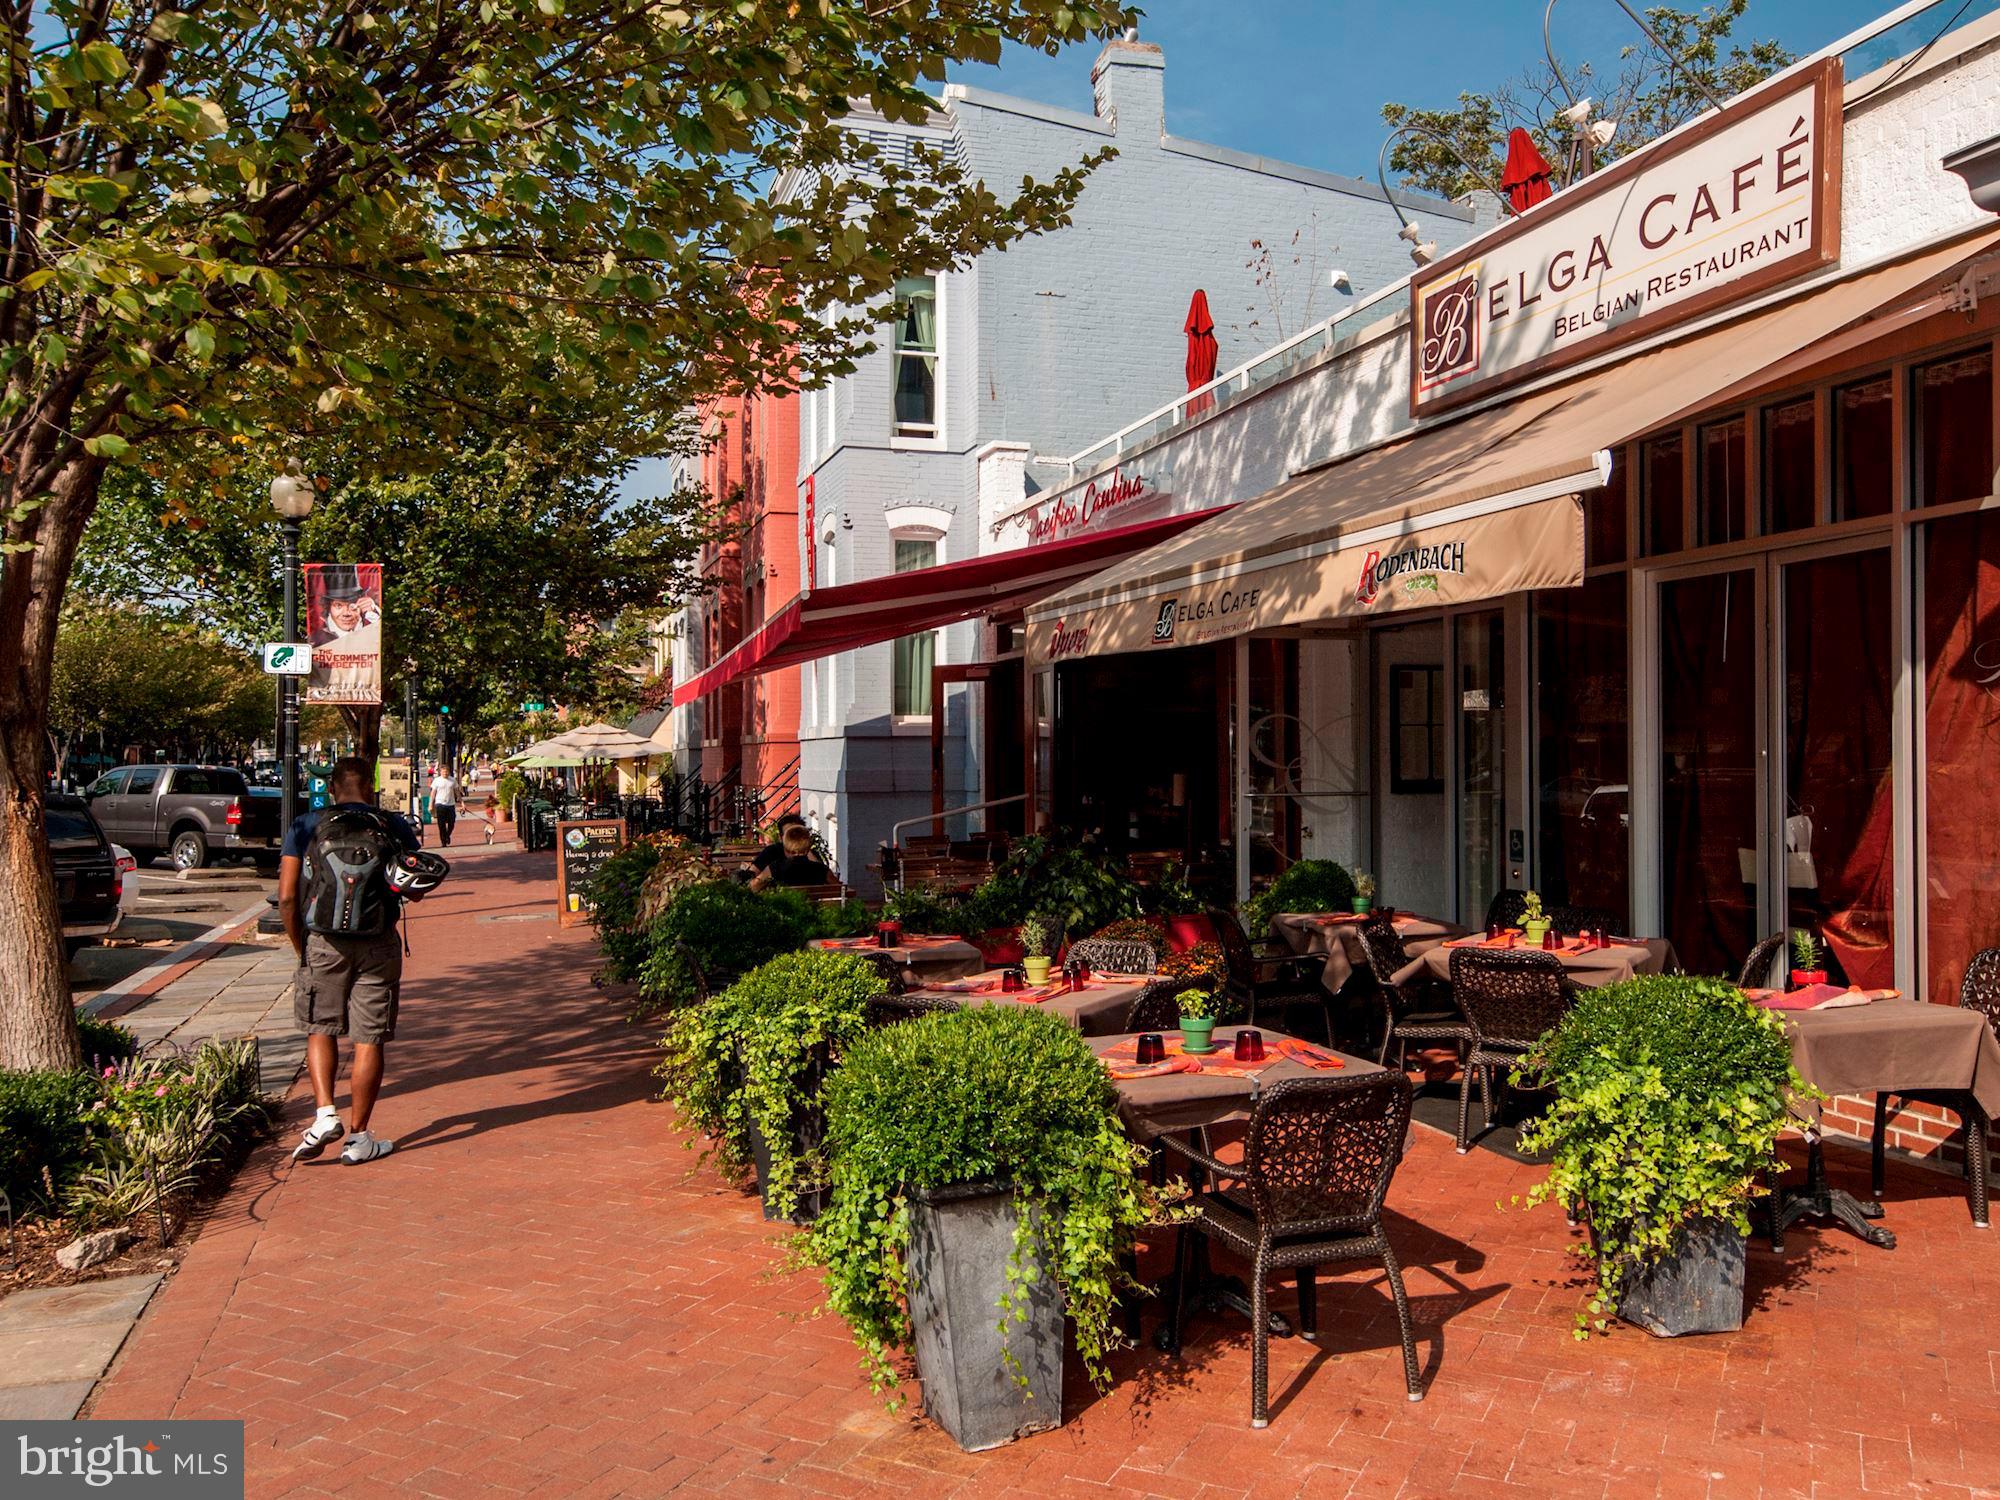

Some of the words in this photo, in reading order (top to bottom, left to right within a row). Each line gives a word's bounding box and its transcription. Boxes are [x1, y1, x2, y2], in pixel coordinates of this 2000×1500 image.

[1639, 115, 1810, 250] CAFÉ
[1553, 288, 1640, 339] BELGIAN
[1646, 217, 1809, 302] RESTAURANT
[1028, 496, 1077, 542] Pacifico
[1082, 466, 1144, 527] Cantina
[1354, 541, 1465, 606] RODENBACH
